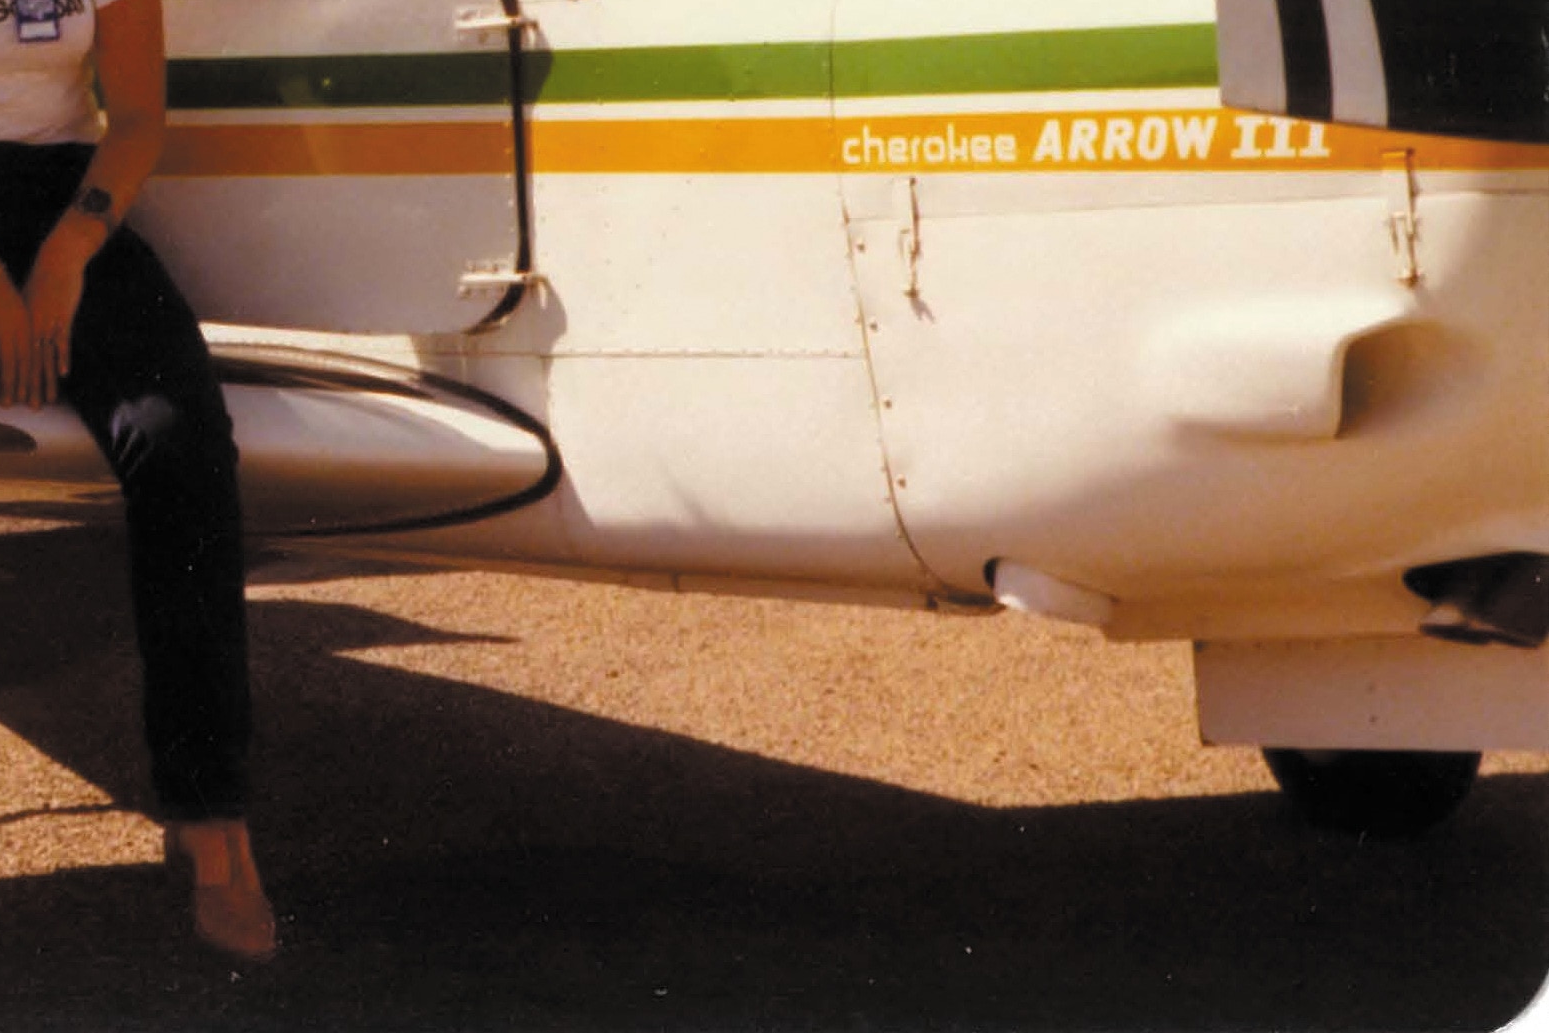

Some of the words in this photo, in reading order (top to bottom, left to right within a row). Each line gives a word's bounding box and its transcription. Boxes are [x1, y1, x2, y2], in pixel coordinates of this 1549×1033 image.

[841, 123, 1017, 164] cherokee
[1033, 116, 1218, 163] ARROW
[1230, 115, 1331, 159] III
